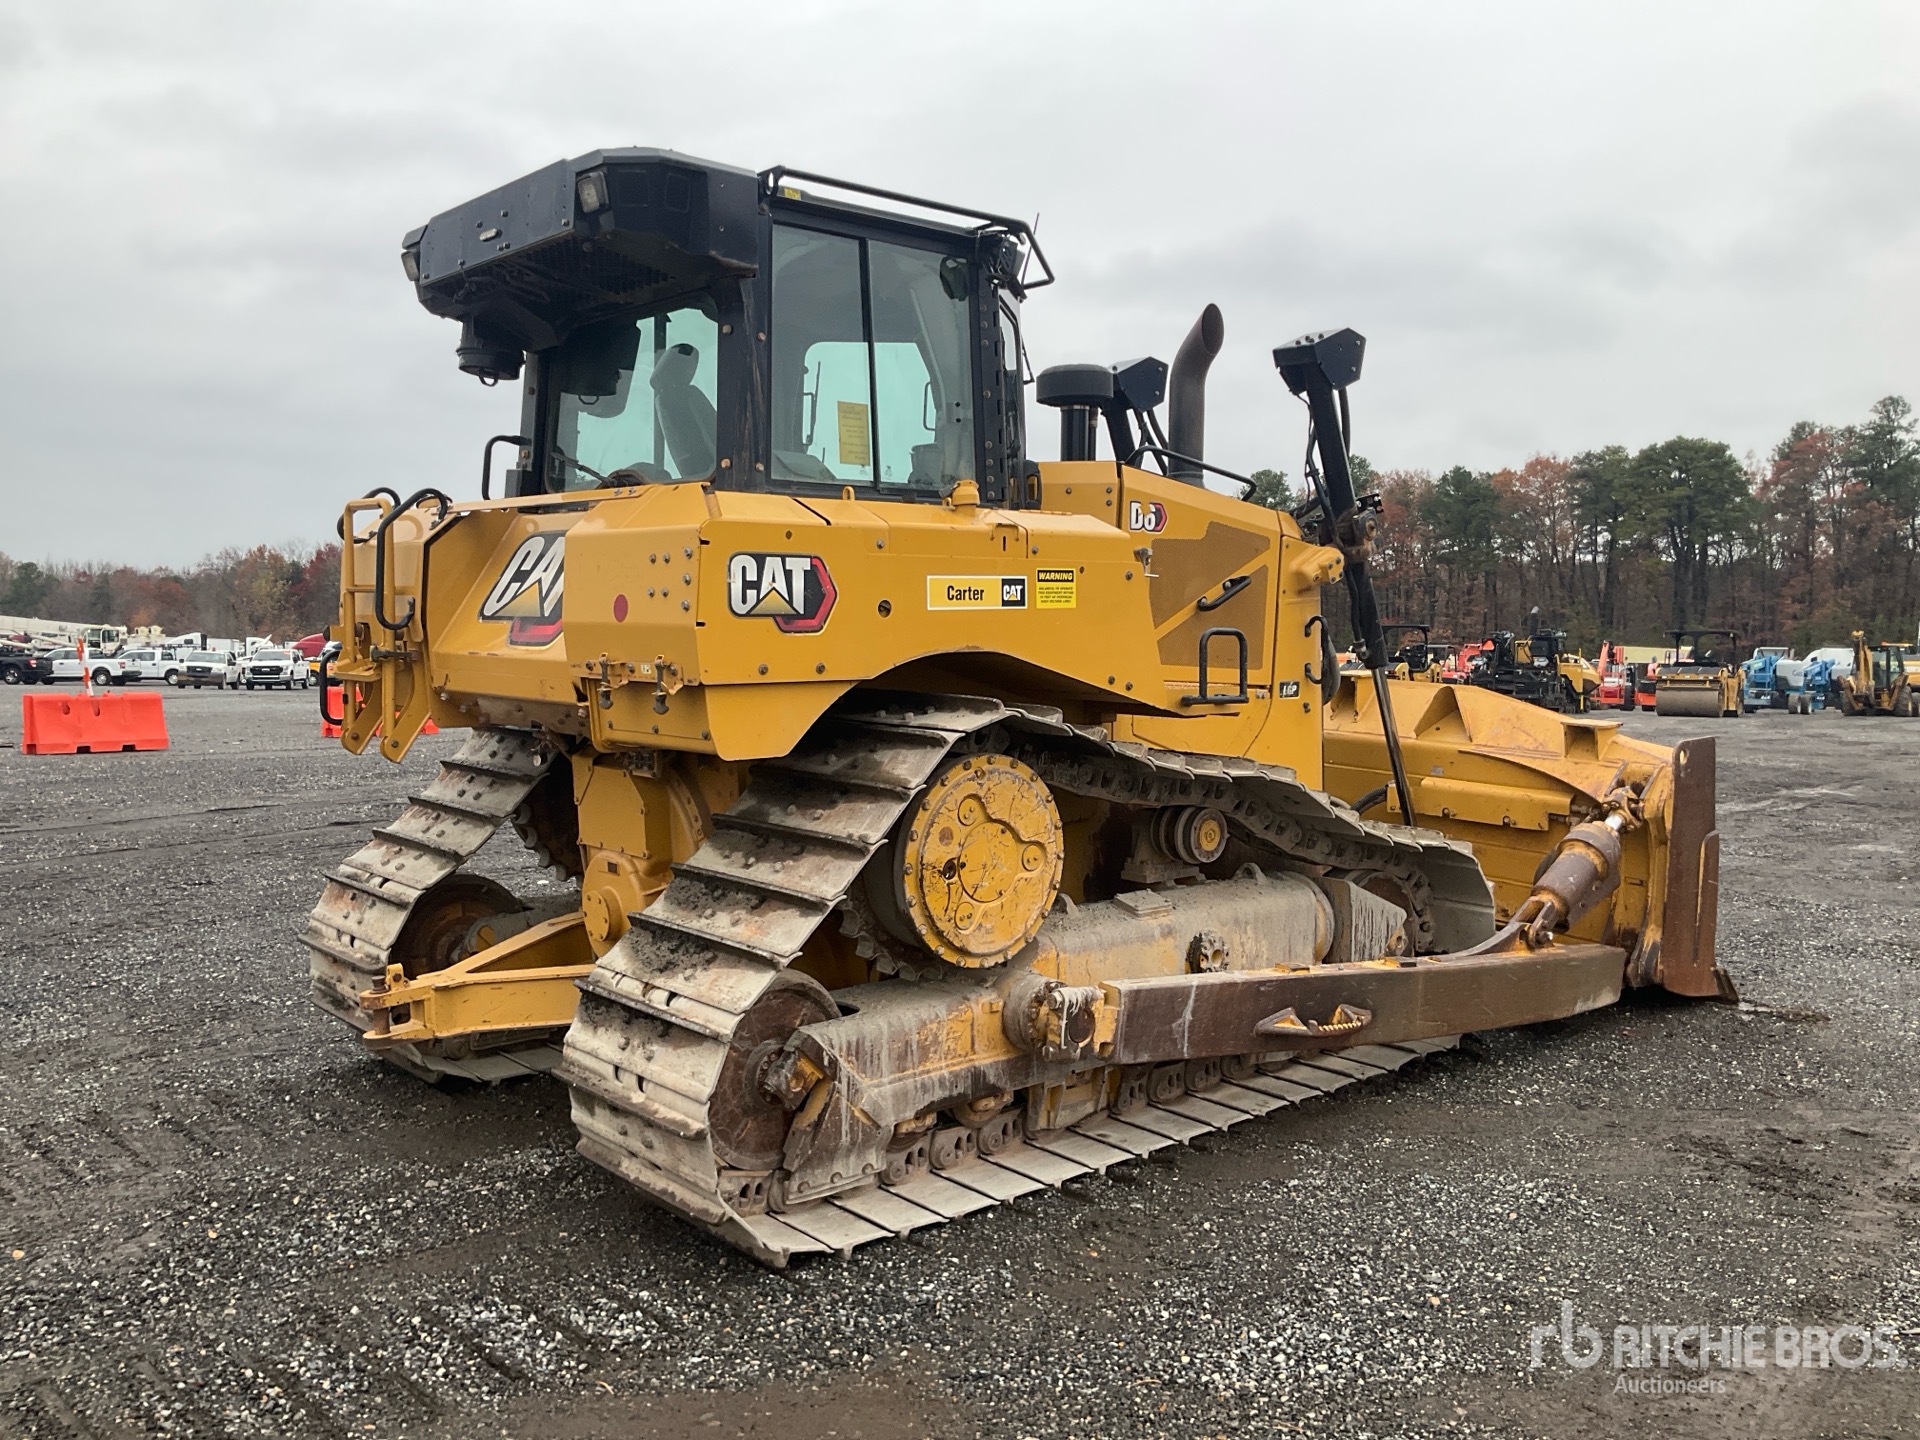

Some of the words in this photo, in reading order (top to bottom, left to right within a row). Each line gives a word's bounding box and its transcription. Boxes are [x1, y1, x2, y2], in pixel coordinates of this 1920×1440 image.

[1130, 501, 1156, 531] D6
[483, 536, 565, 617] CA
[730, 554, 811, 615] CAT
[1039, 572, 1073, 580] WARNING
[947, 584, 985, 601] Carter
[1002, 584, 1024, 601] CAT
